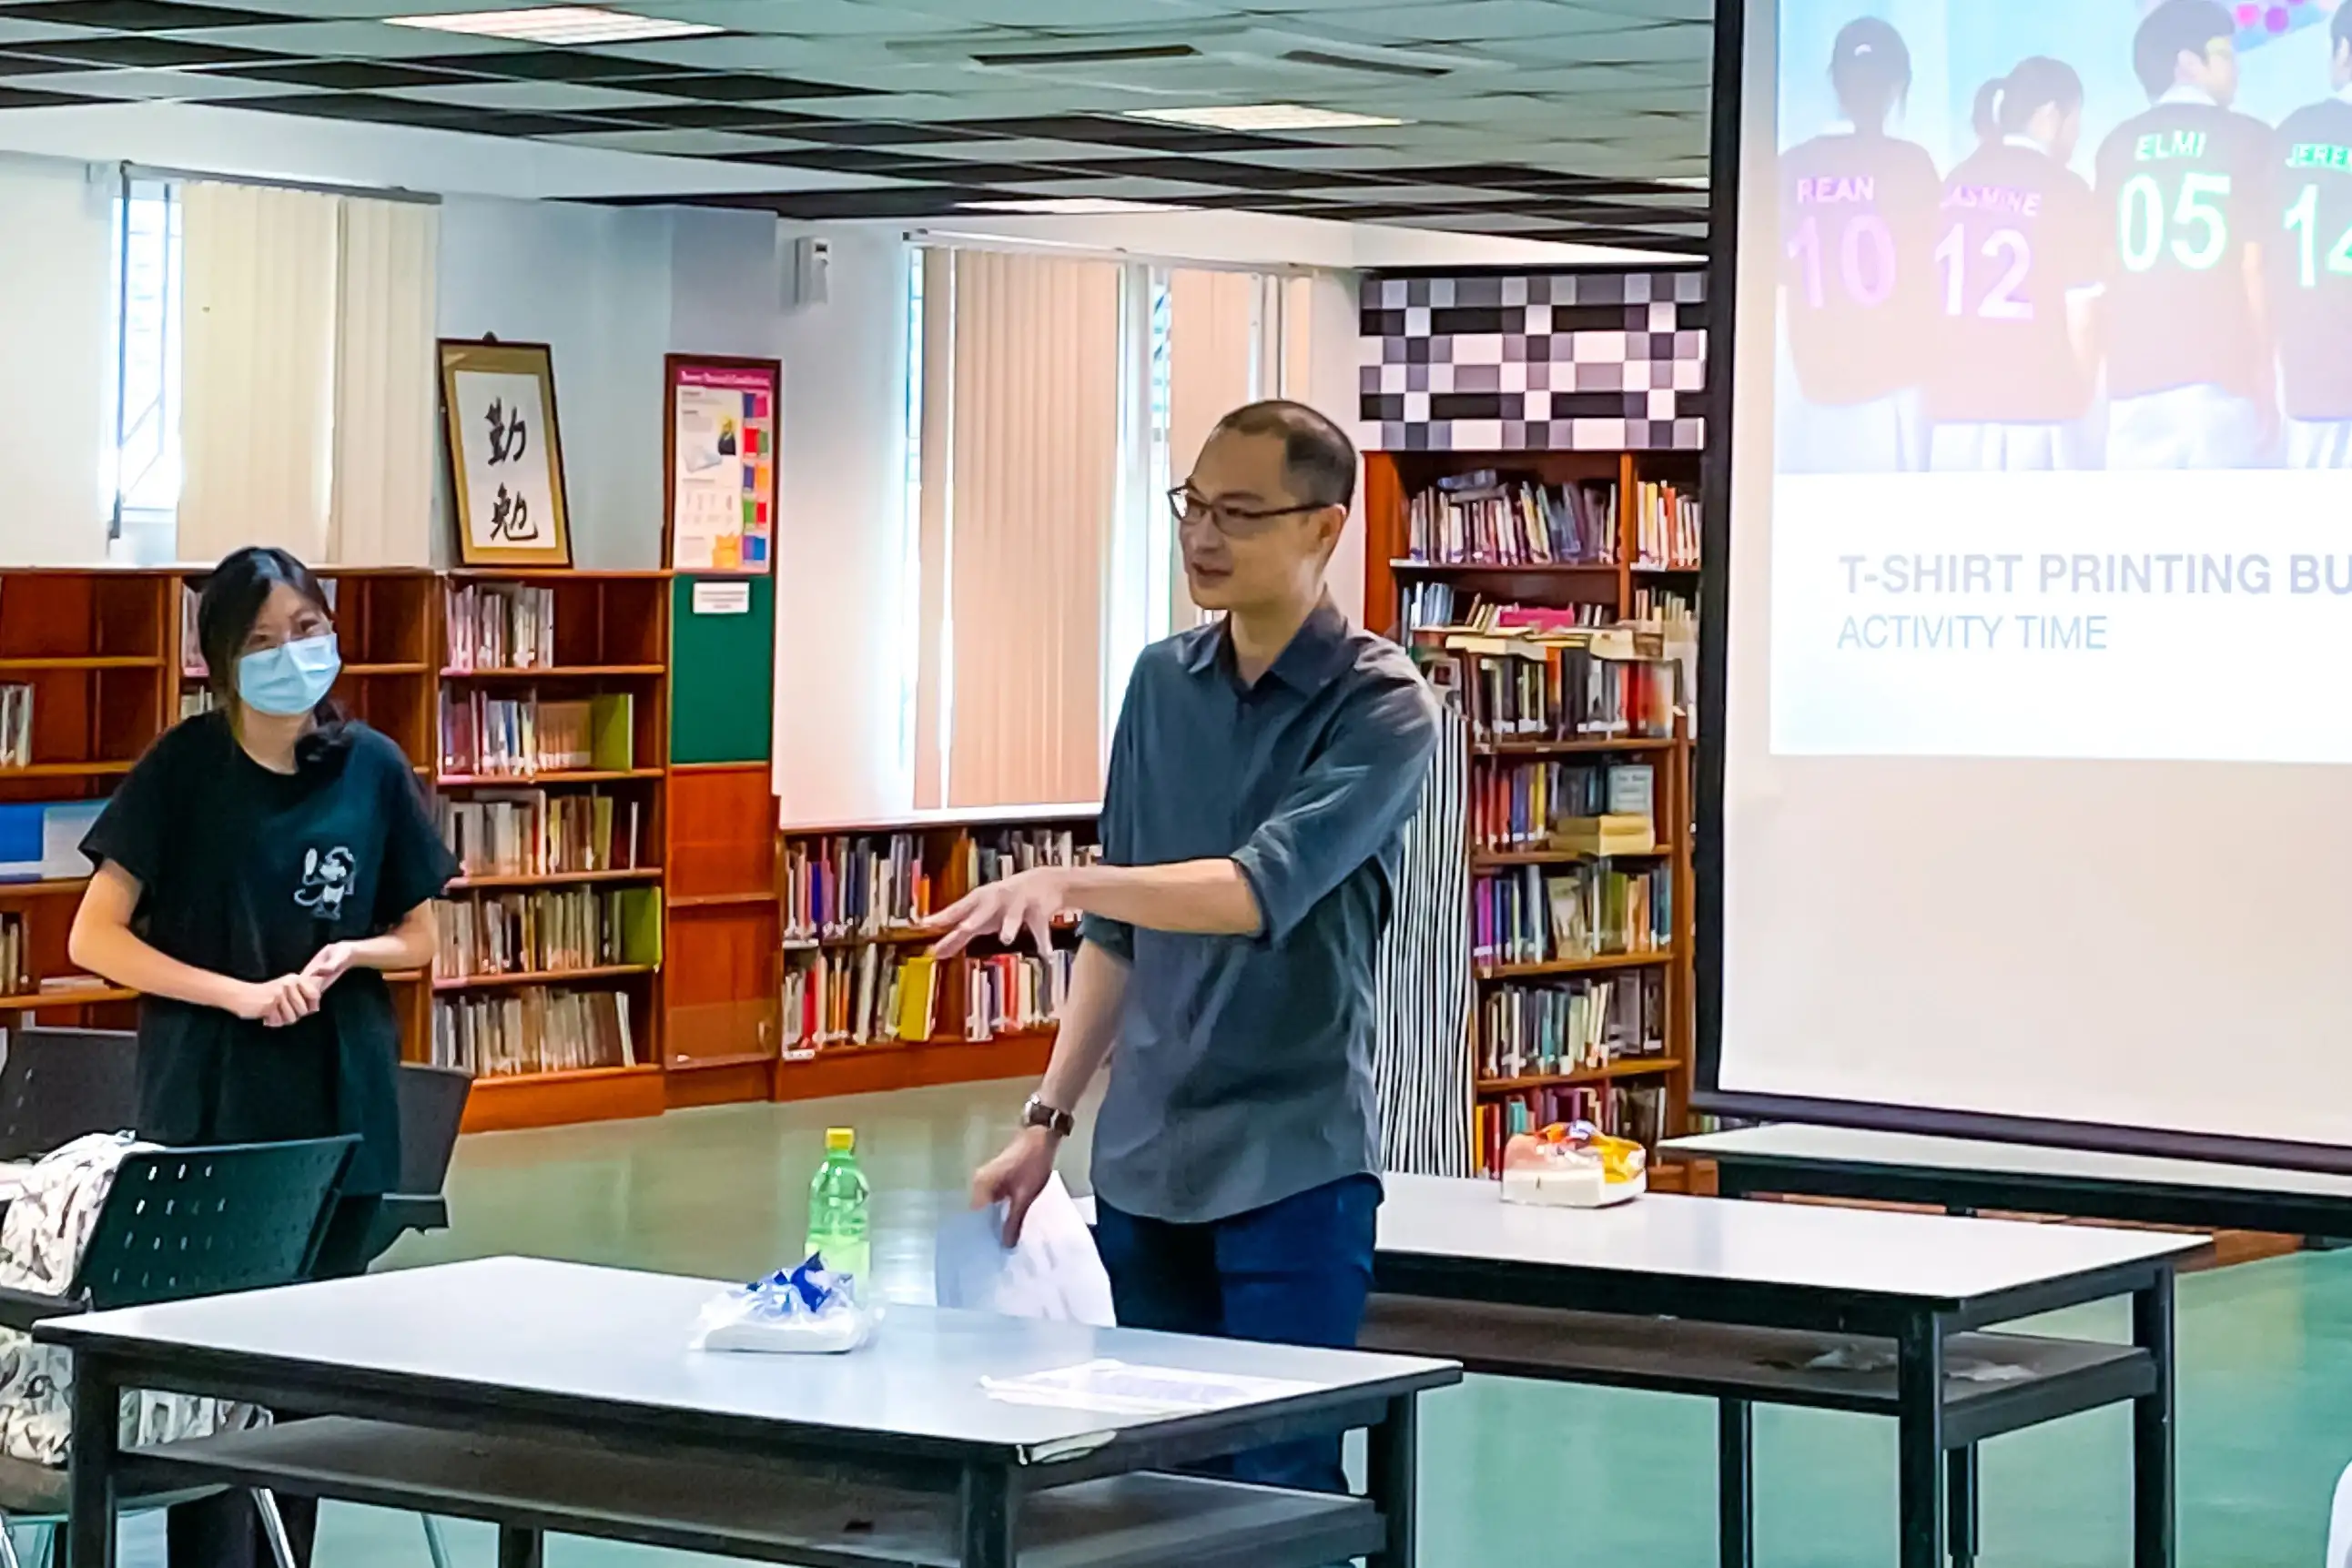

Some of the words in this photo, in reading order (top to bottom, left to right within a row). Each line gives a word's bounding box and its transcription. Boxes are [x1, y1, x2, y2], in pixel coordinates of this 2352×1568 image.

[2135, 129, 2206, 161] ELMI
[2285, 143, 2352, 172] JERE
[1797, 176, 1875, 204] REAN
[2117, 173, 2231, 273] 05
[1787, 215, 1897, 309] 10
[1934, 223, 2034, 320] 12
[484, 397, 539, 541] 勤勉
[1839, 554, 2023, 593] T-SHIRT
[2039, 554, 2272, 594] PRINTING
[2290, 554, 2352, 595] BU
[1837, 615, 2002, 650] ACTIVITY
[2015, 615, 2108, 650] TIME
